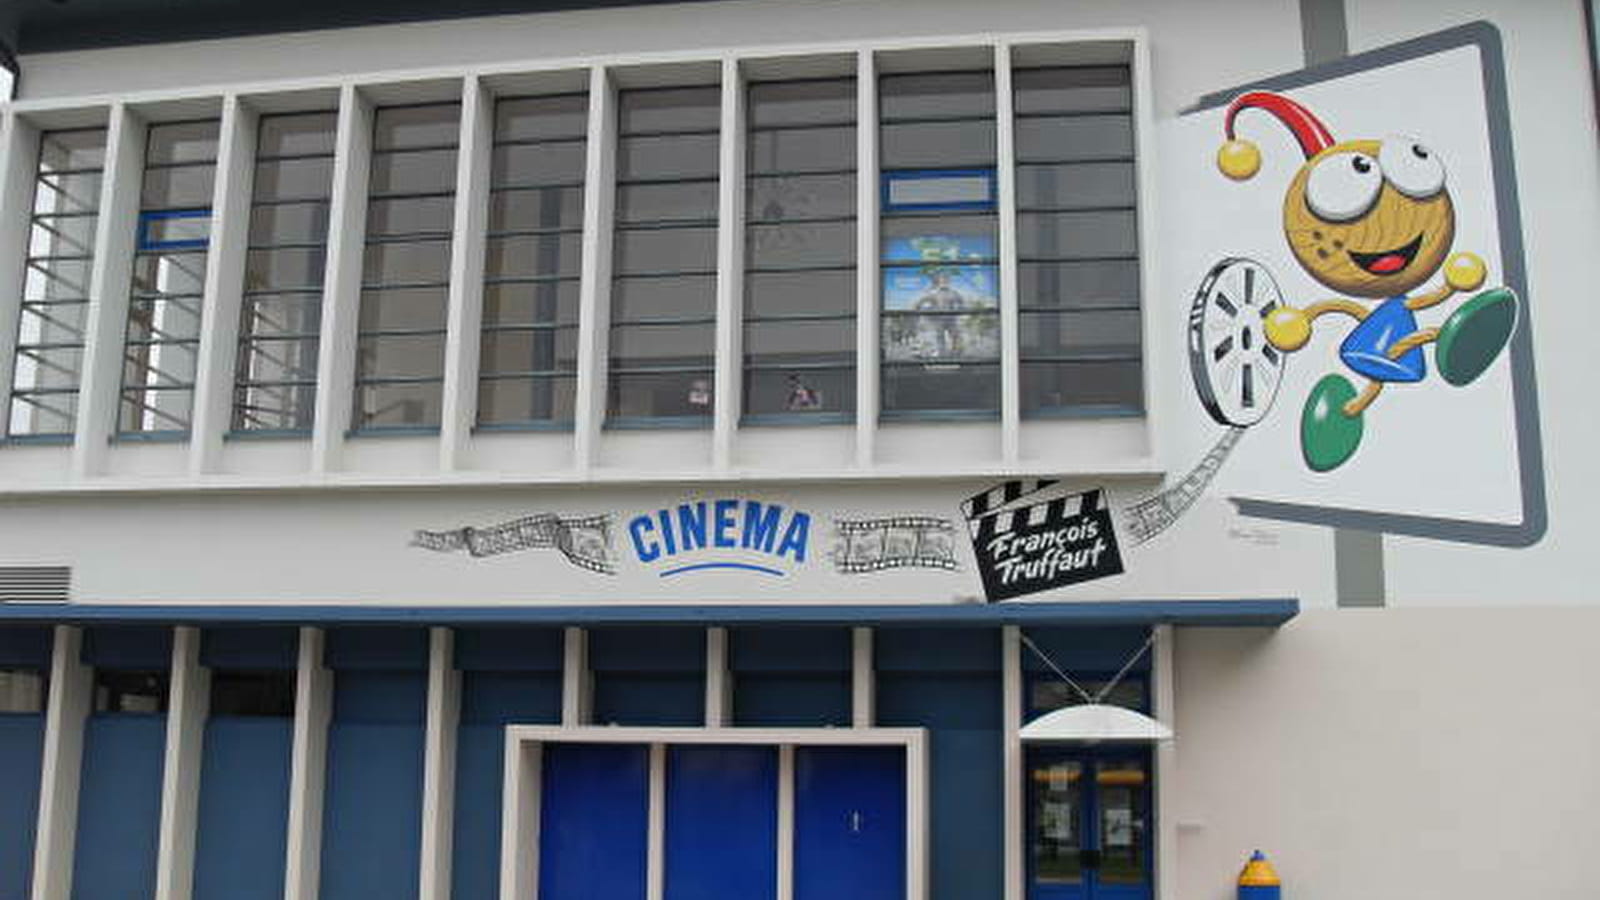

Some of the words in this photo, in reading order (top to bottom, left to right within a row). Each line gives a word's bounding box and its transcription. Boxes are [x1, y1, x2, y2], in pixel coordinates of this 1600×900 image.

[629, 499, 811, 563] CINEMA
[986, 517, 1099, 560] François
[994, 538, 1107, 585] Truffaut
